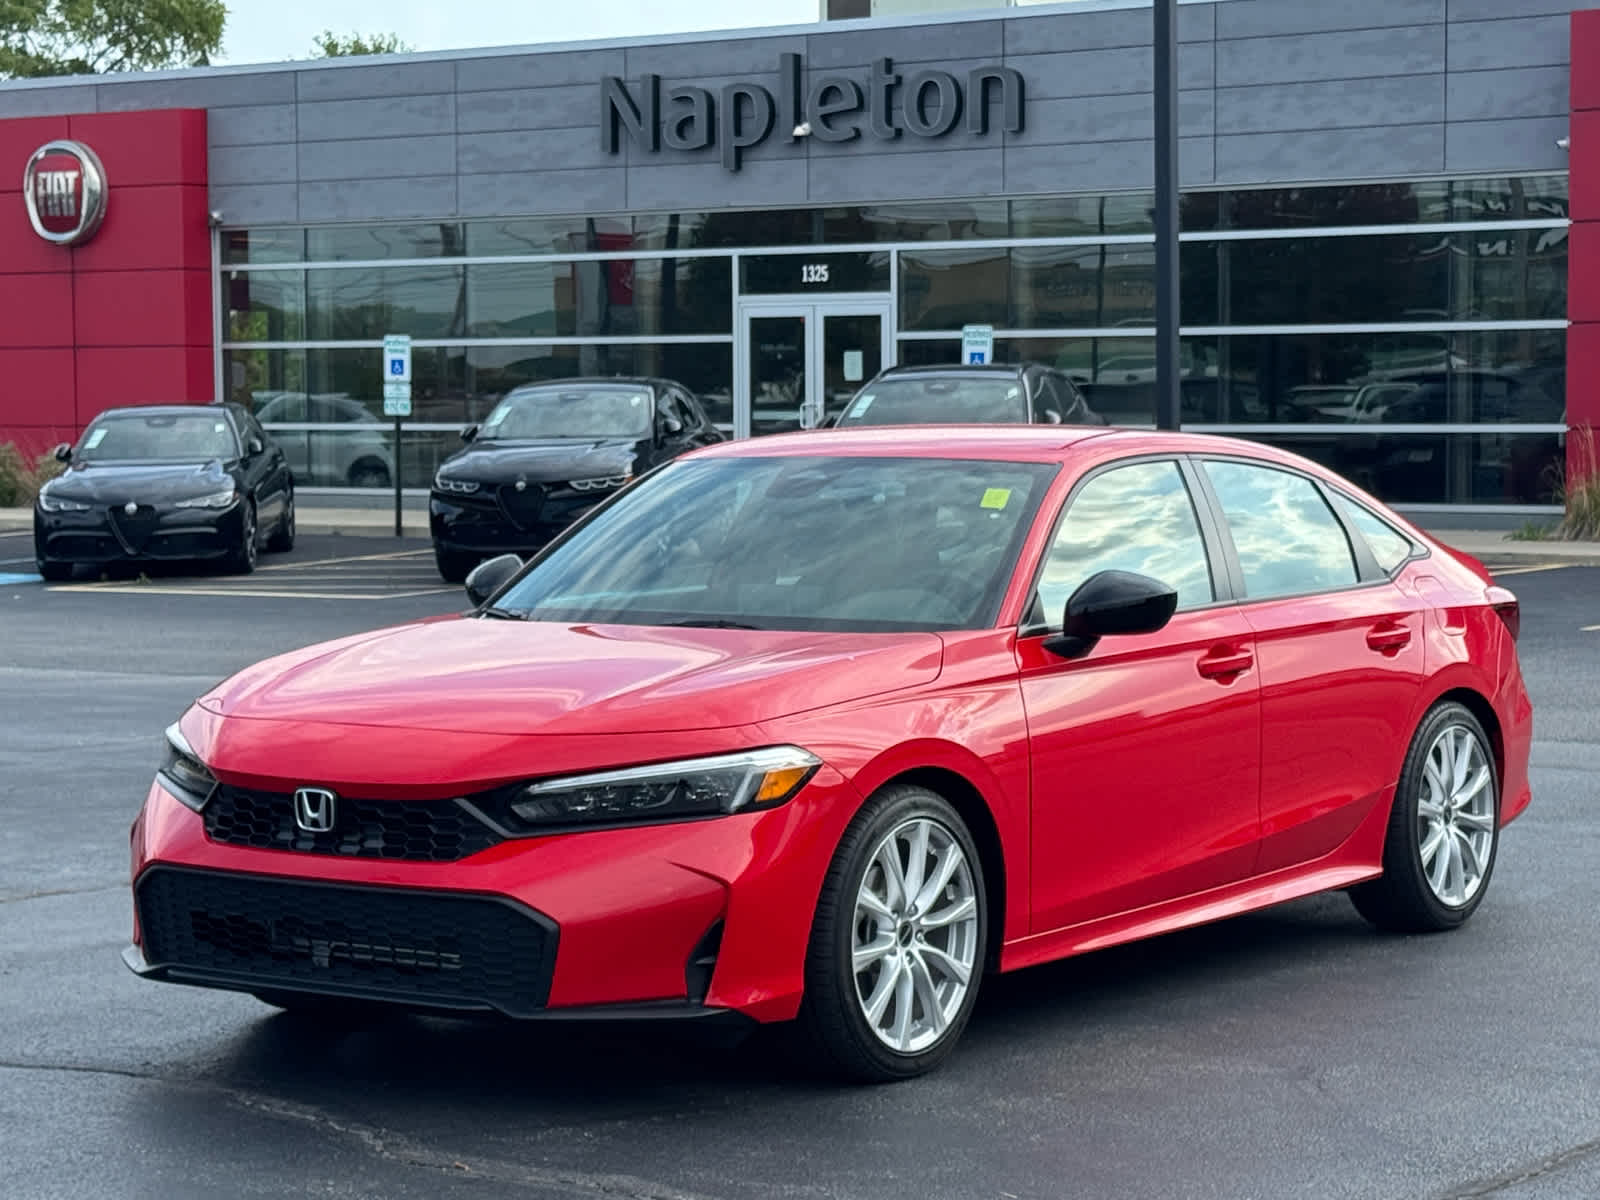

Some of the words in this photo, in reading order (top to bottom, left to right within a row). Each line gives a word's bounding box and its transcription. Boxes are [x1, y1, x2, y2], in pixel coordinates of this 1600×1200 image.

[601, 53, 1025, 172] Napleton
[38, 171, 79, 216] FIAT
[802, 265, 829, 282] 1325
